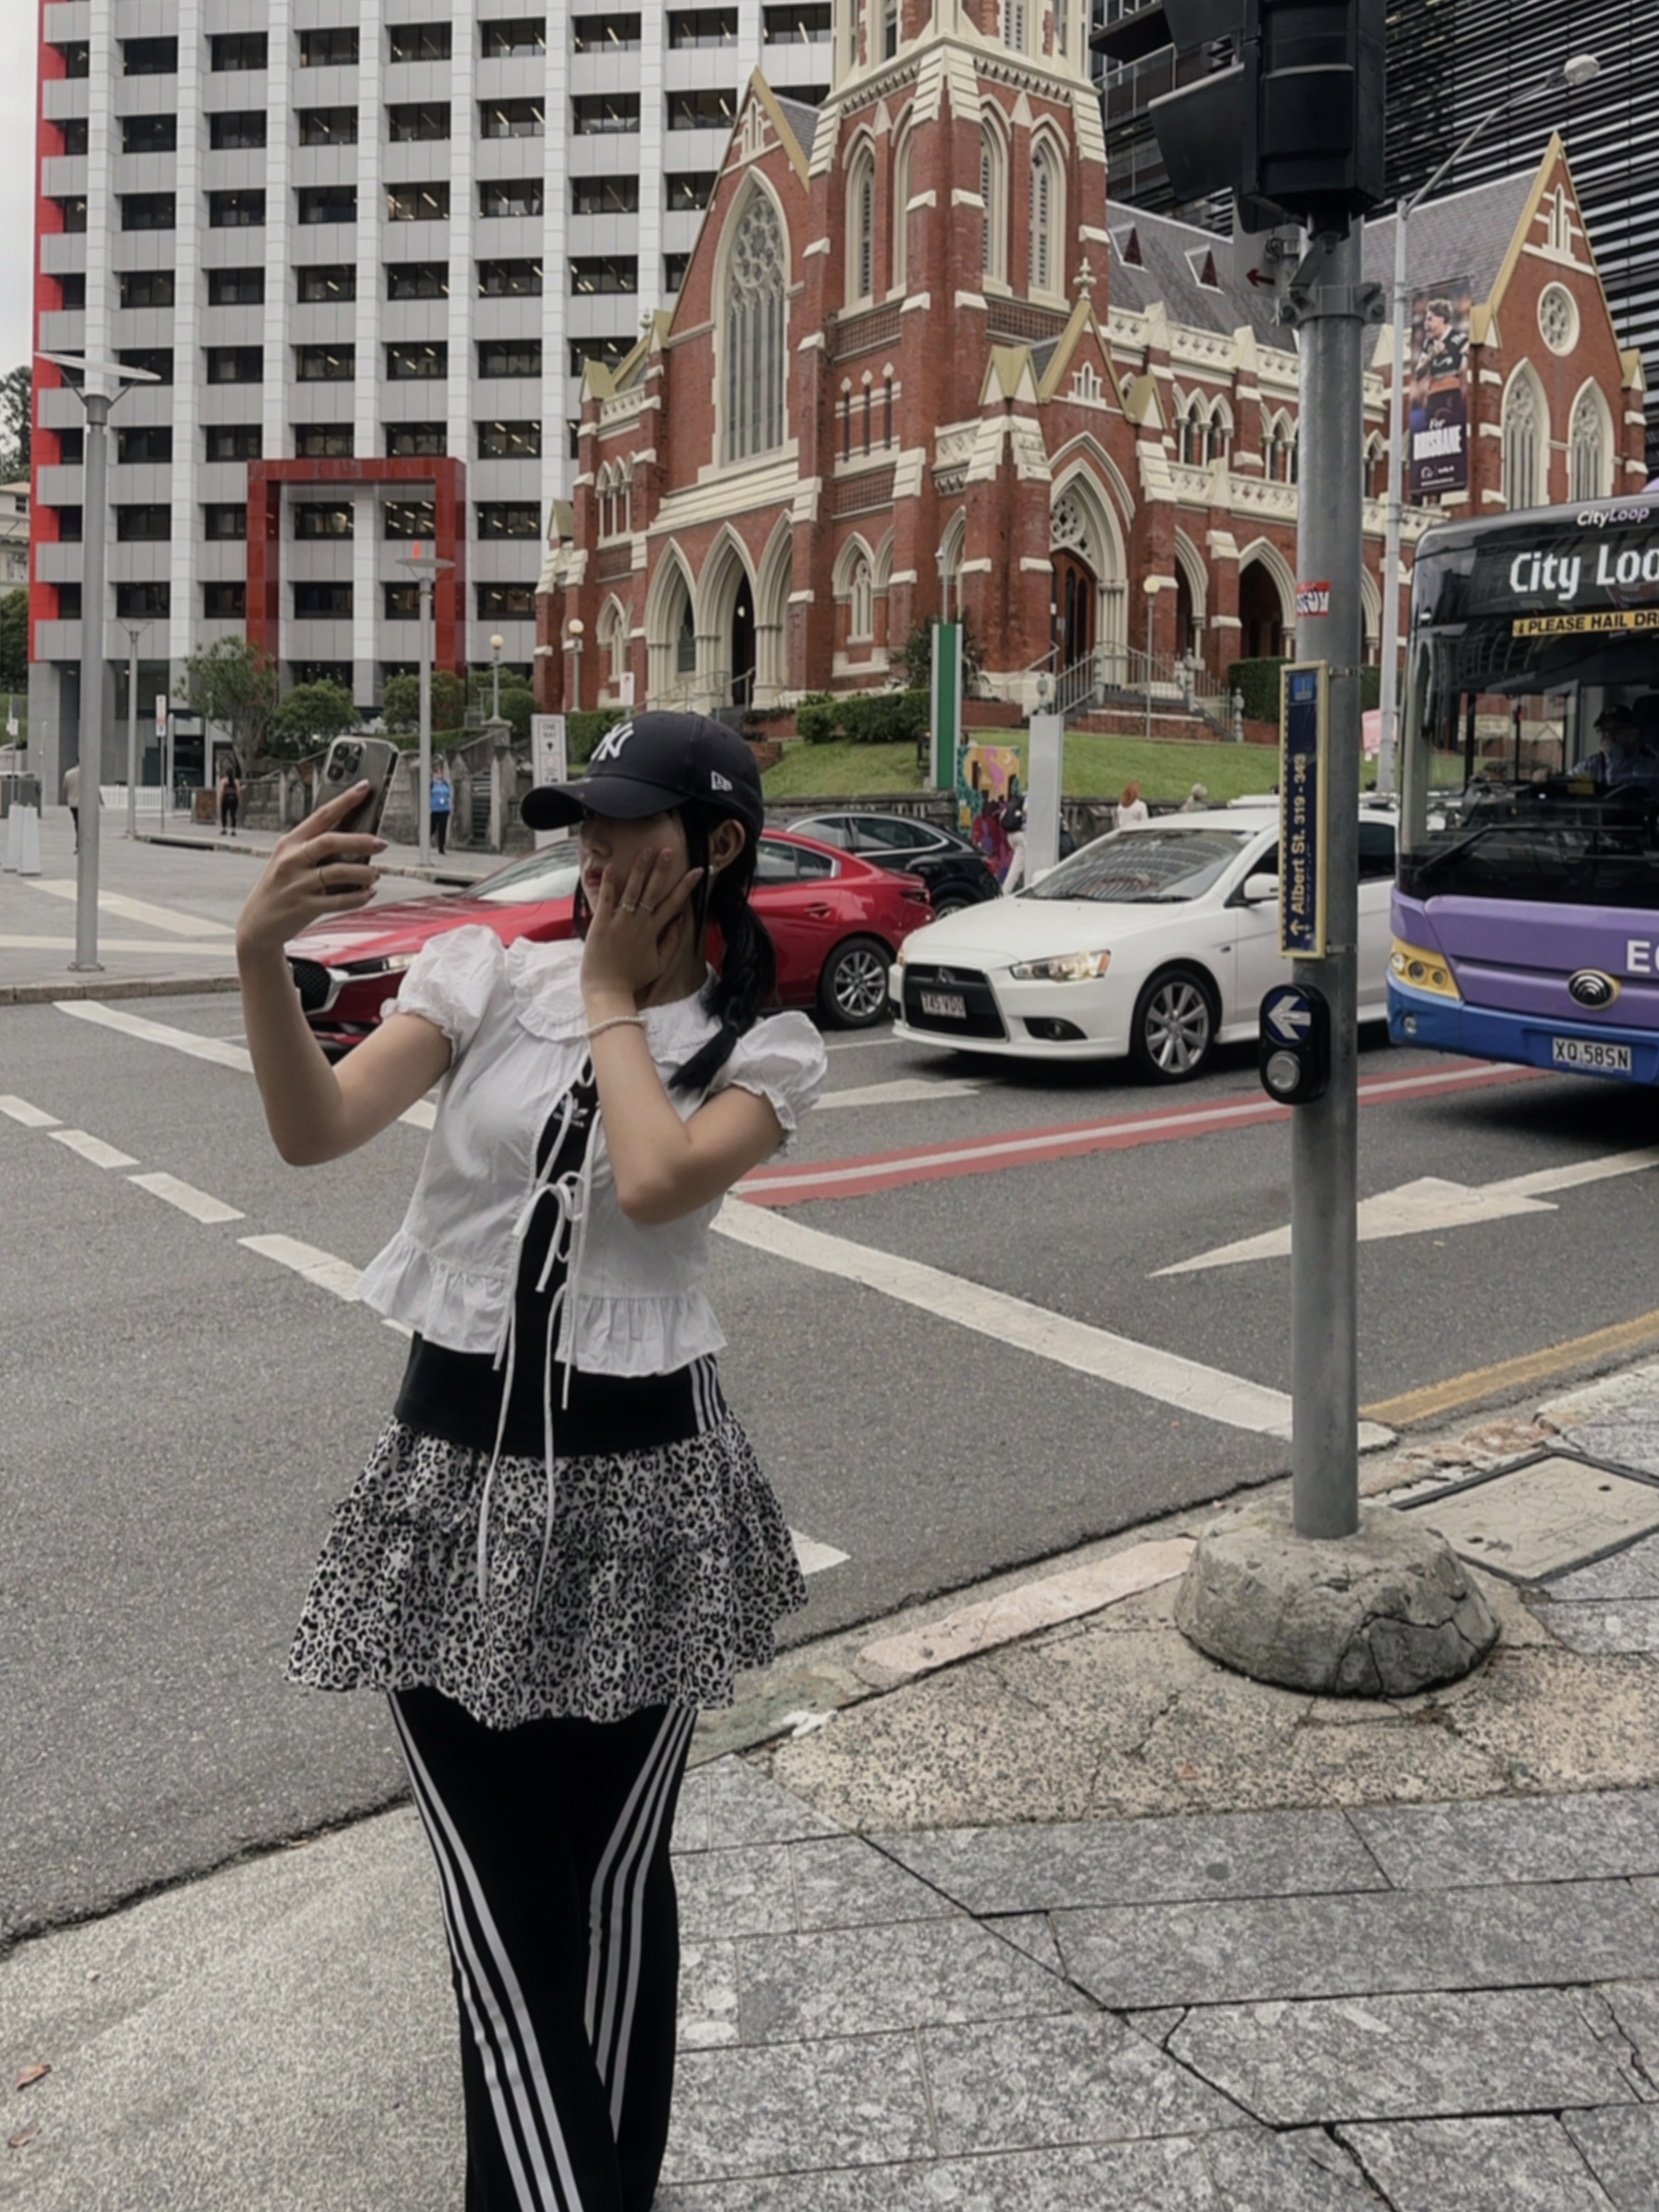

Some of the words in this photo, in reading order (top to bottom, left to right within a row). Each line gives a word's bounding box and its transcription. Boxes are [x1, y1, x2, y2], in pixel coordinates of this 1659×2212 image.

[1577, 507, 1649, 528] CityLoop
[1509, 551, 1581, 601] City
[1597, 544, 1659, 586] Loo
[1529, 617, 1585, 632] PLEASE
[1591, 614, 1627, 628] HAIL
[1635, 611, 1659, 625] DR
[591, 722, 634, 761] NY
[1294, 796, 1306, 825] 319
[1291, 829, 1306, 855] St.
[1291, 859, 1305, 915] Albert
[1627, 939, 1659, 973] E
